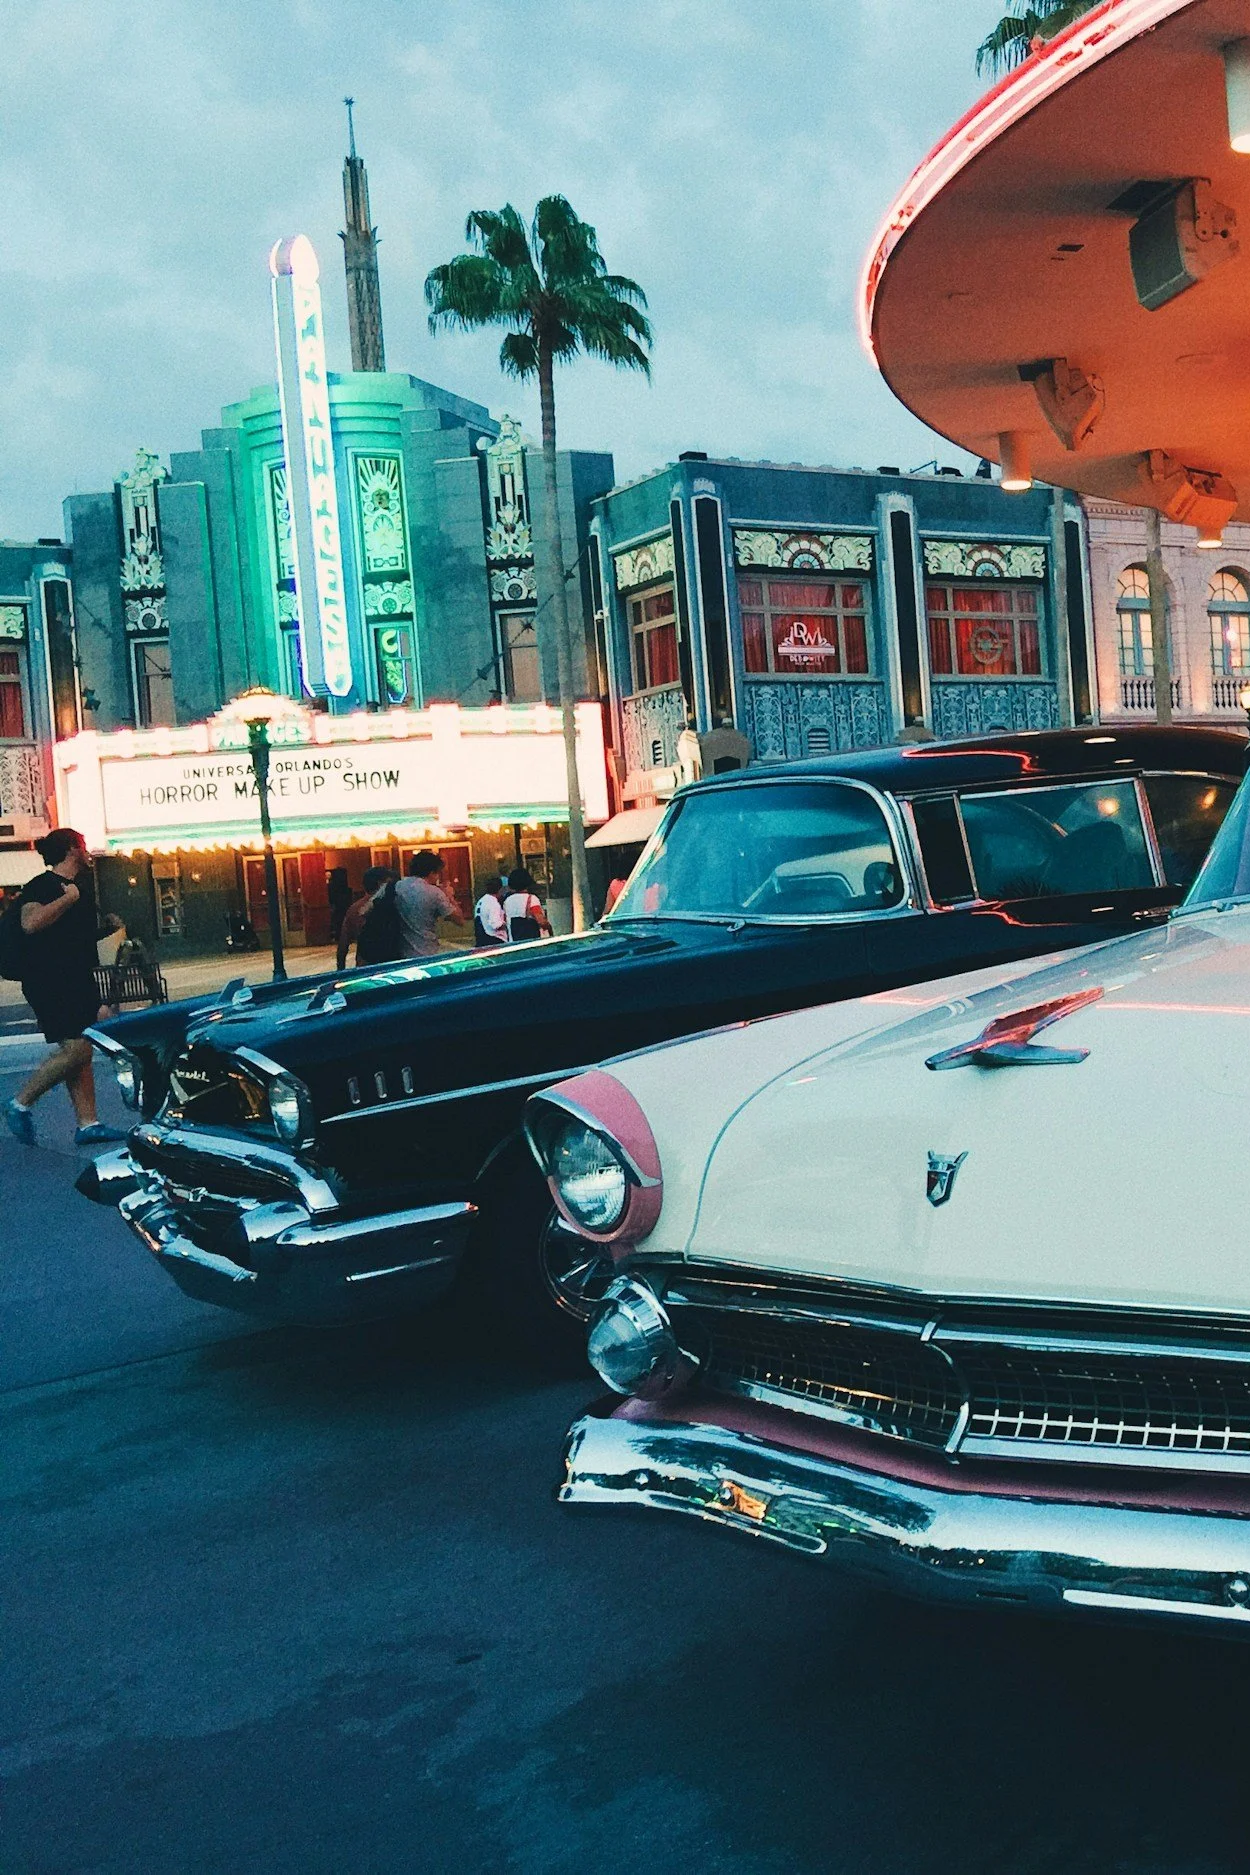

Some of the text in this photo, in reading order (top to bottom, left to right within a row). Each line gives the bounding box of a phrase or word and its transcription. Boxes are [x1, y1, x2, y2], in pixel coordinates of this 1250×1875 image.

[183, 757, 353, 779] UNIVERSA ORLANDOS
[140, 783, 218, 805] HORROR
[299, 775, 325, 795] UP
[343, 769, 400, 791] SHOW
